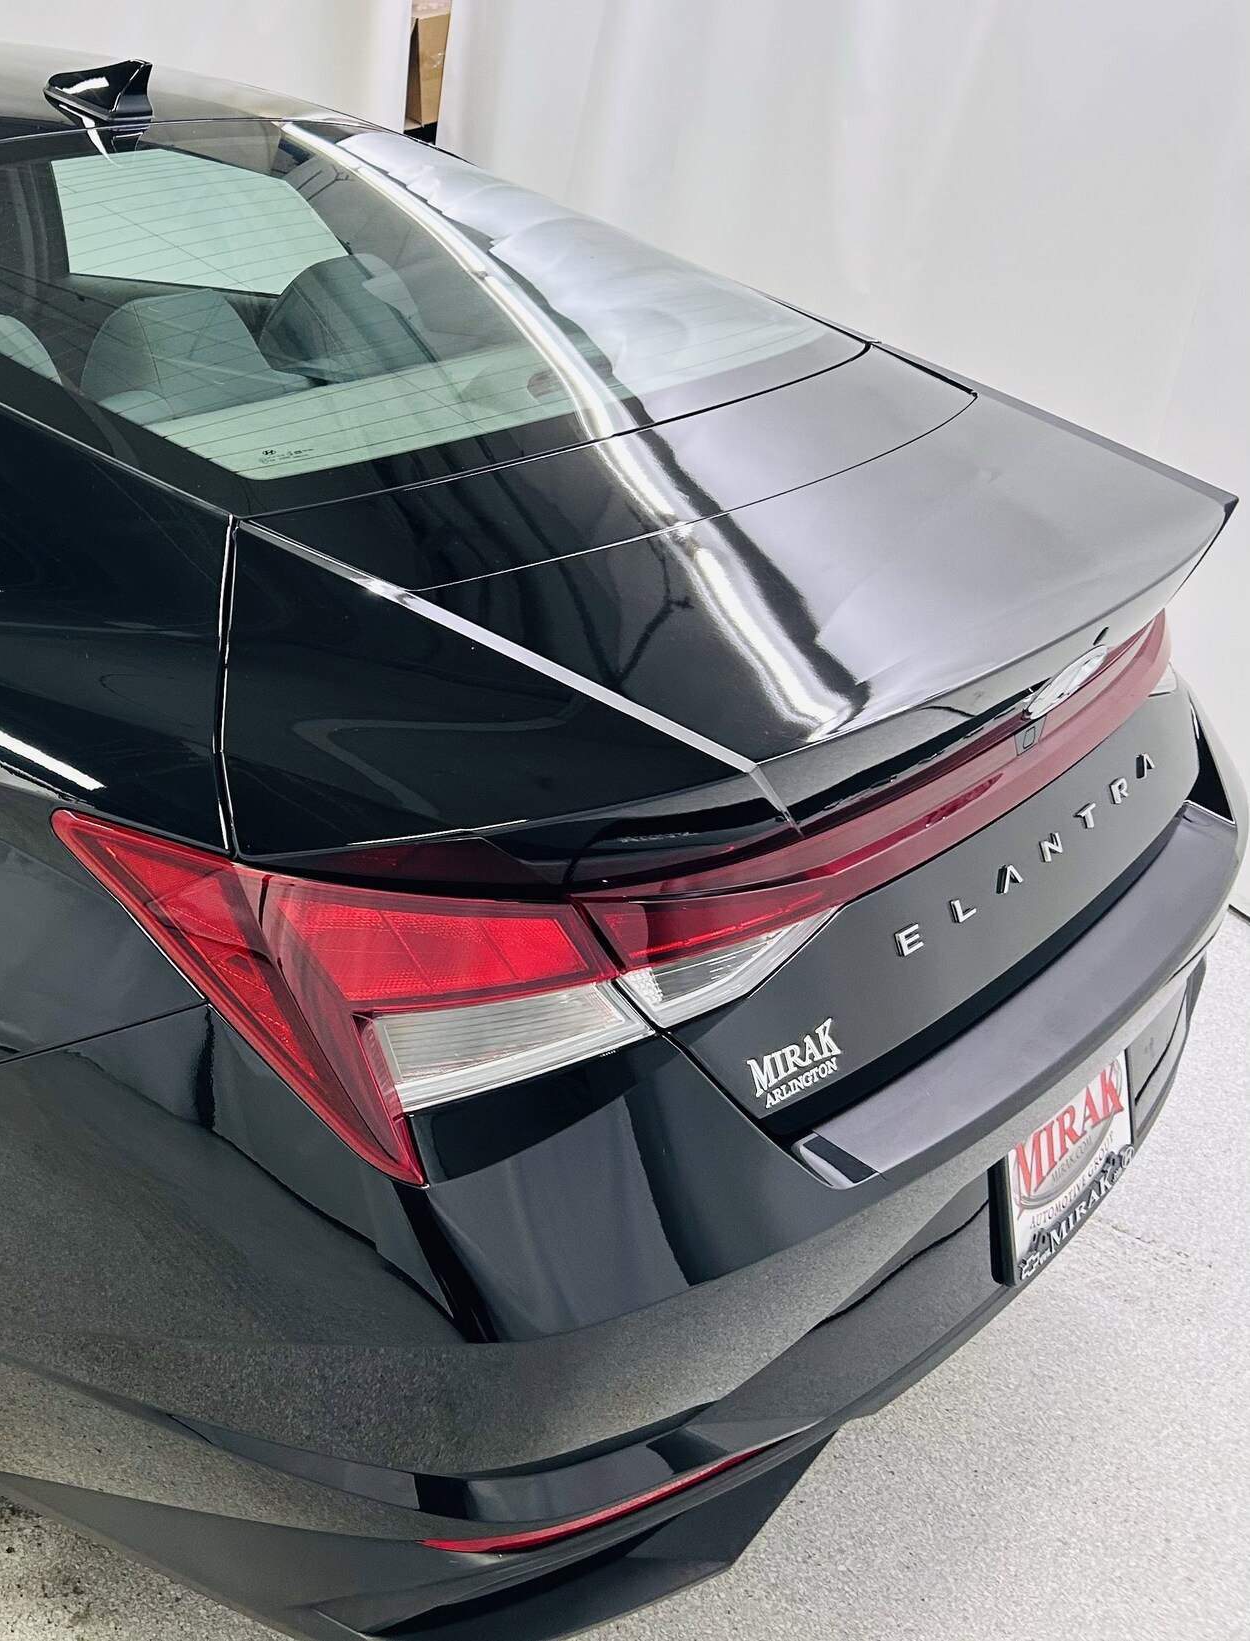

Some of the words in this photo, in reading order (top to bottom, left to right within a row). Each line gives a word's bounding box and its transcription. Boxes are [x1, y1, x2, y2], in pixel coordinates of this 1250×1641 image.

[893, 753, 1155, 957] ELANTRA
[746, 1017, 842, 1098] MIRAK
[765, 1057, 838, 1109] ARLINGTON
[1014, 1059, 1125, 1212] MIRAK
[1029, 1176, 1087, 1230] AUTOMOTIVE
[1087, 1129, 1115, 1178] GROUP
